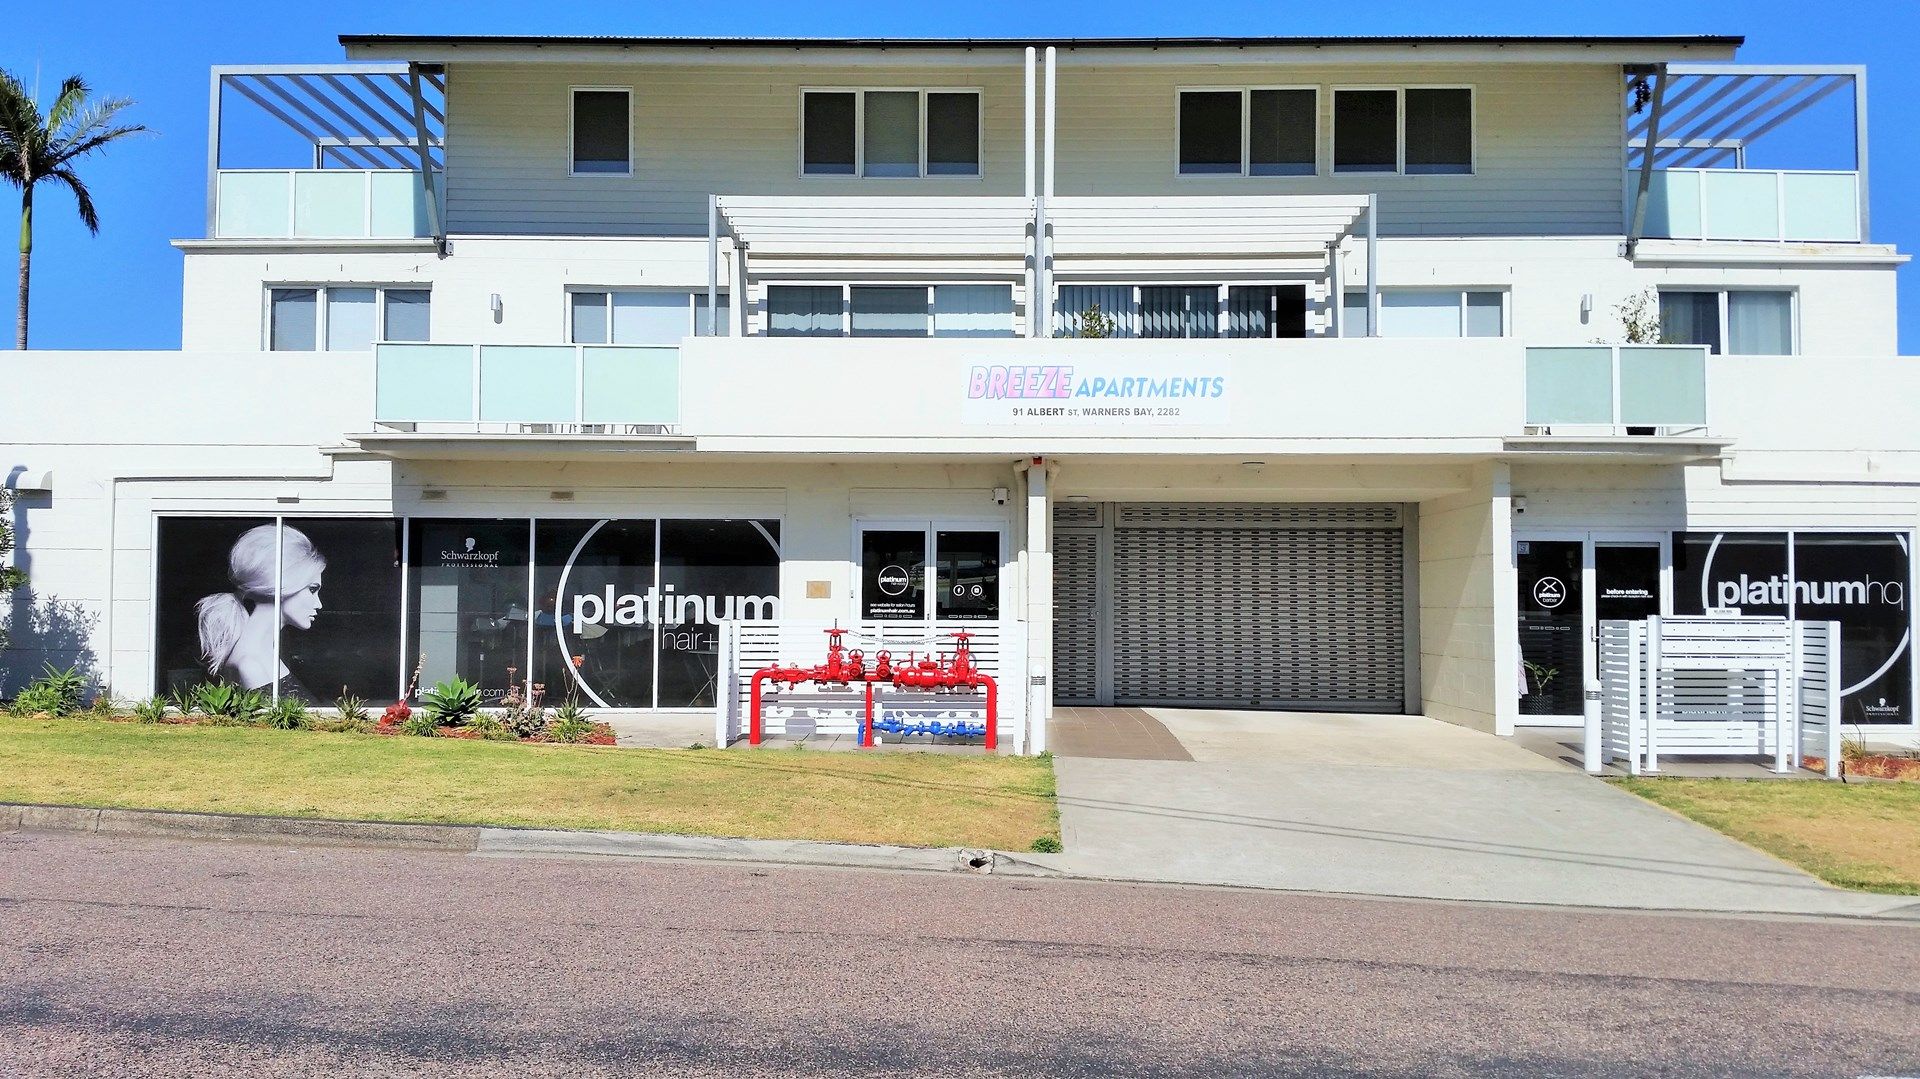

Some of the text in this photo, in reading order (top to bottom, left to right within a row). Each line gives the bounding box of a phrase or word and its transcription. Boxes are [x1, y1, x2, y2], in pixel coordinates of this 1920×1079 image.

[968, 365, 1225, 400] BREEZE APARTMENTS
[1012, 408, 1180, 417] 91 ALBERT ST, WARNERS BAY, 2282
[441, 550, 499, 563] Schwarzkopf
[573, 584, 780, 634] platinum
